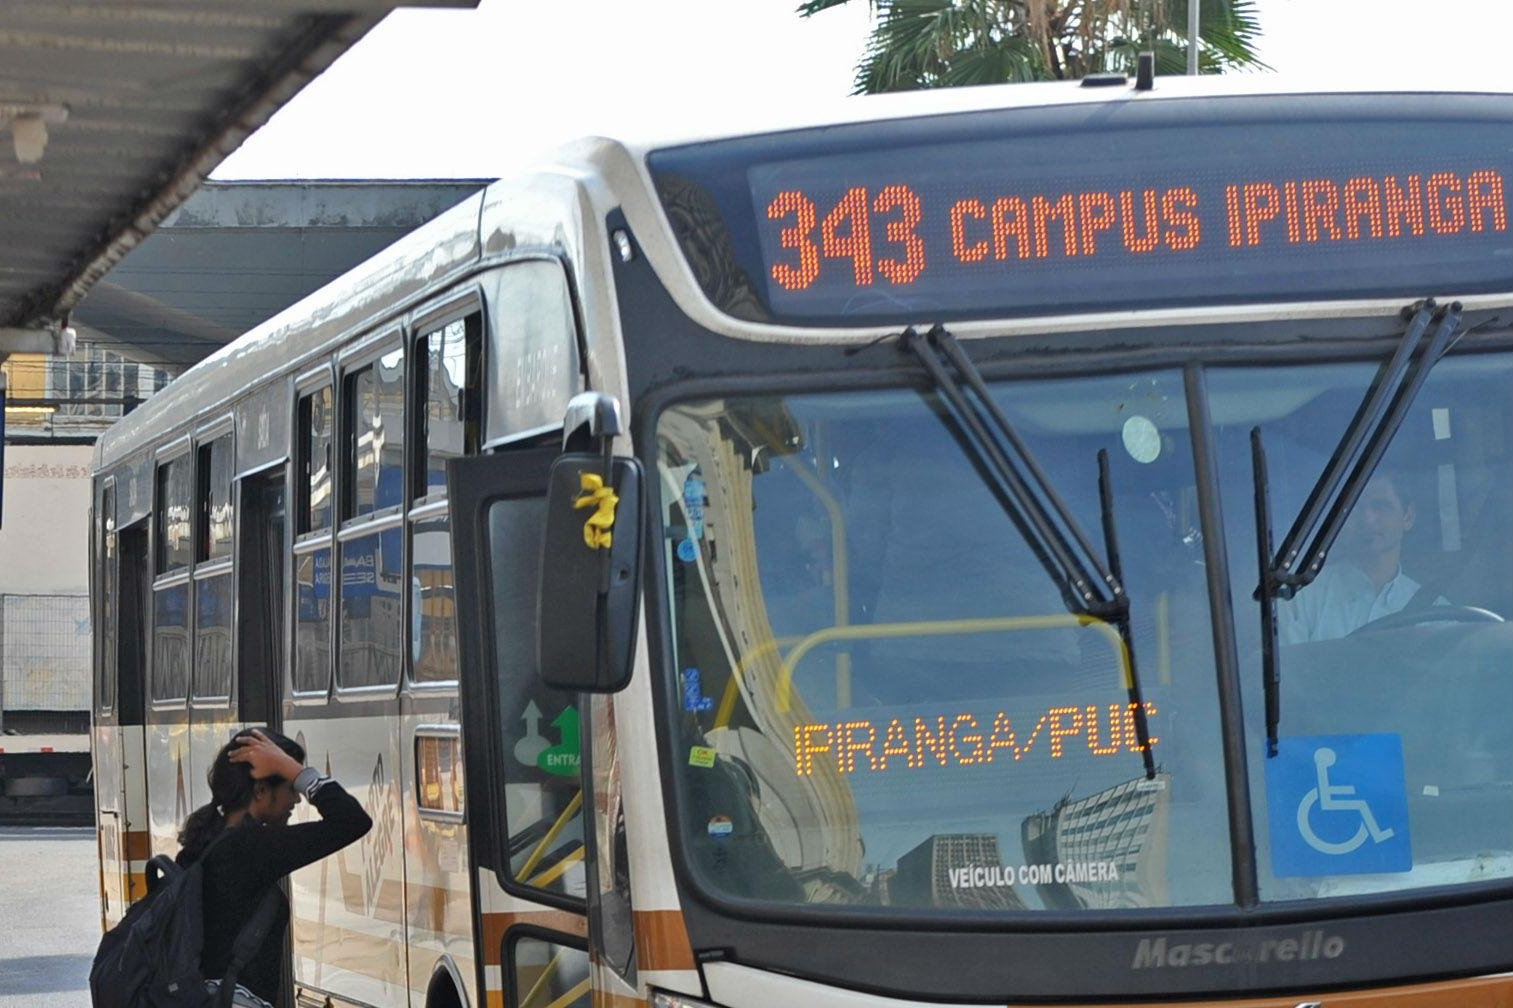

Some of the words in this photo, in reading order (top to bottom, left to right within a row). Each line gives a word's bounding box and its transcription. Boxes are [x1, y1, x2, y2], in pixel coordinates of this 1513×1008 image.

[767, 183, 926, 290] 343
[950, 186, 1201, 263] CAMPUS
[1225, 169, 1507, 248] IPIRANGA
[365, 784, 396, 915] ALEGRE
[948, 863, 1016, 888] VEÍCULO
[1018, 863, 1053, 885] COM
[1054, 859, 1119, 884] CÂMERA
